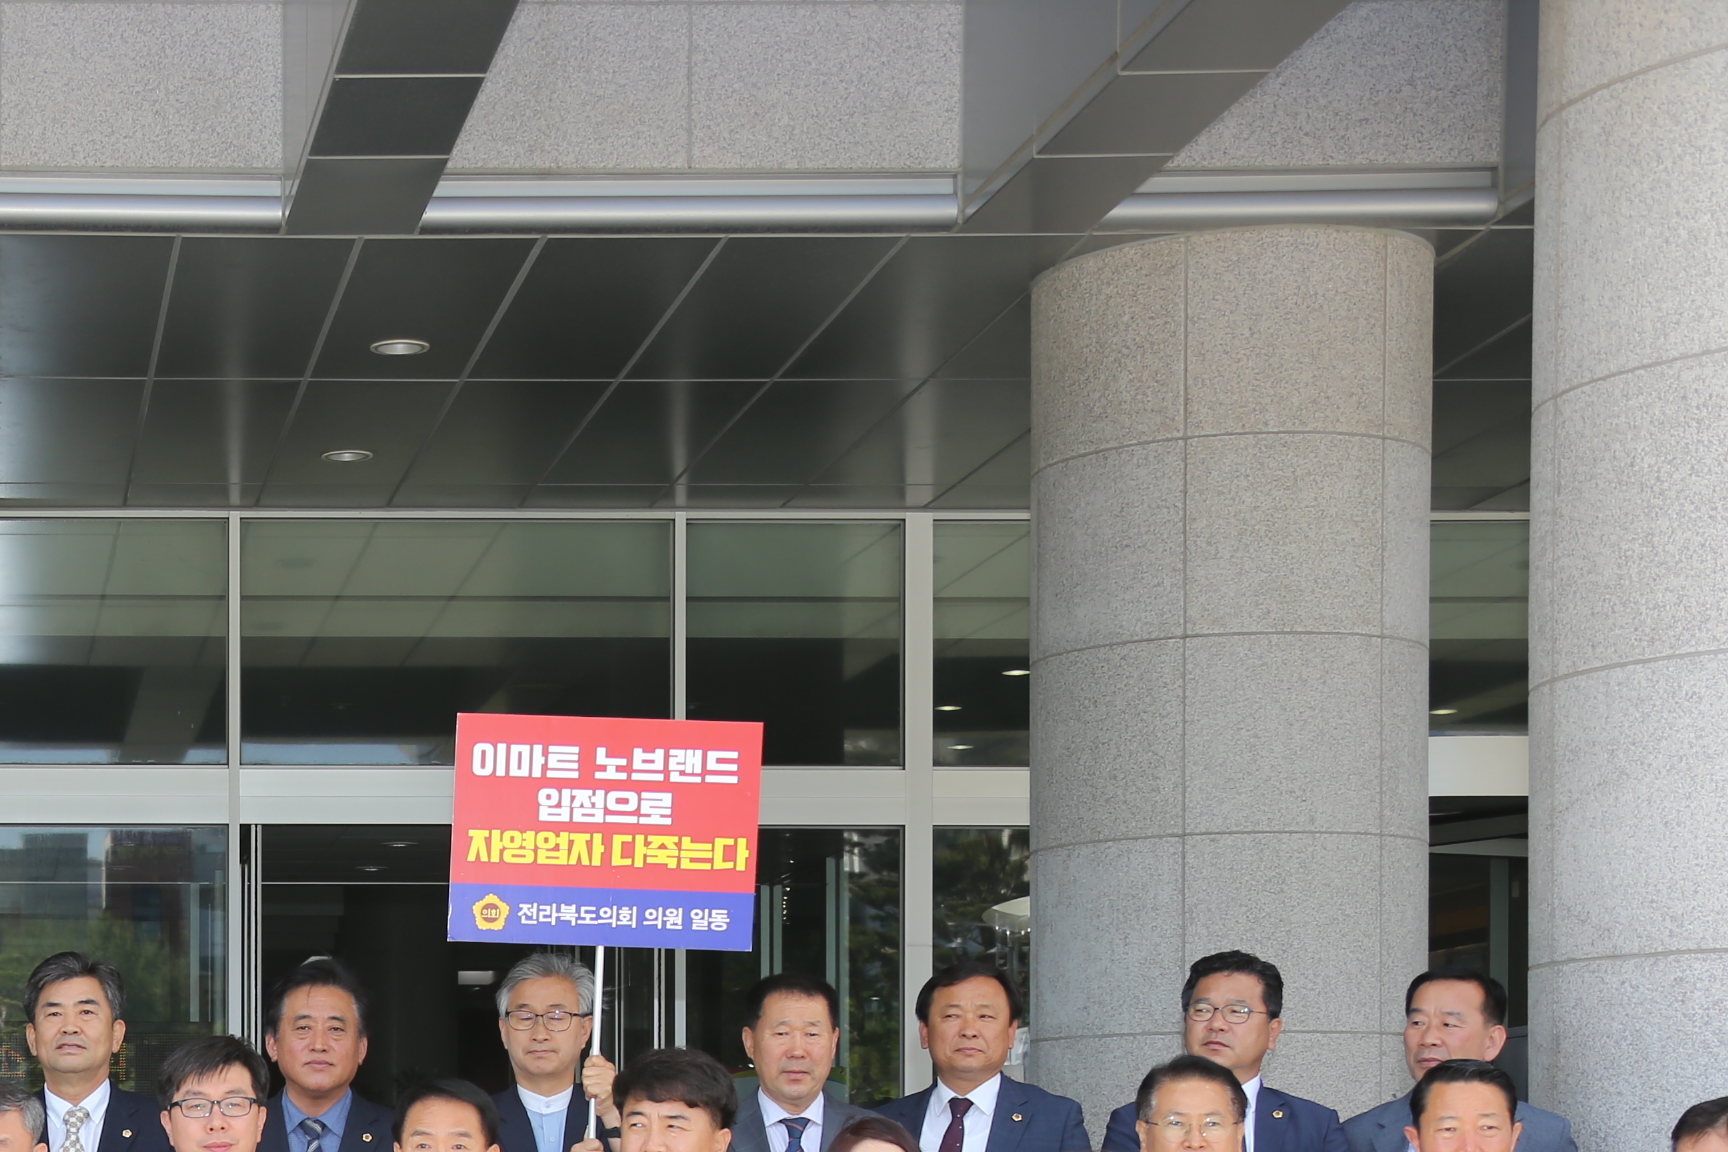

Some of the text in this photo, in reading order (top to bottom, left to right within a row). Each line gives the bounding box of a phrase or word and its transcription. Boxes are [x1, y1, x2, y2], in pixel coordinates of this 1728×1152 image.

[472, 742, 739, 784] 이마트 노브랜드
[538, 788, 672, 825] 입점으로
[467, 829, 749, 871] 자영업자 다죽는다
[518, 903, 729, 931] 전라북도의회 의원 일동
